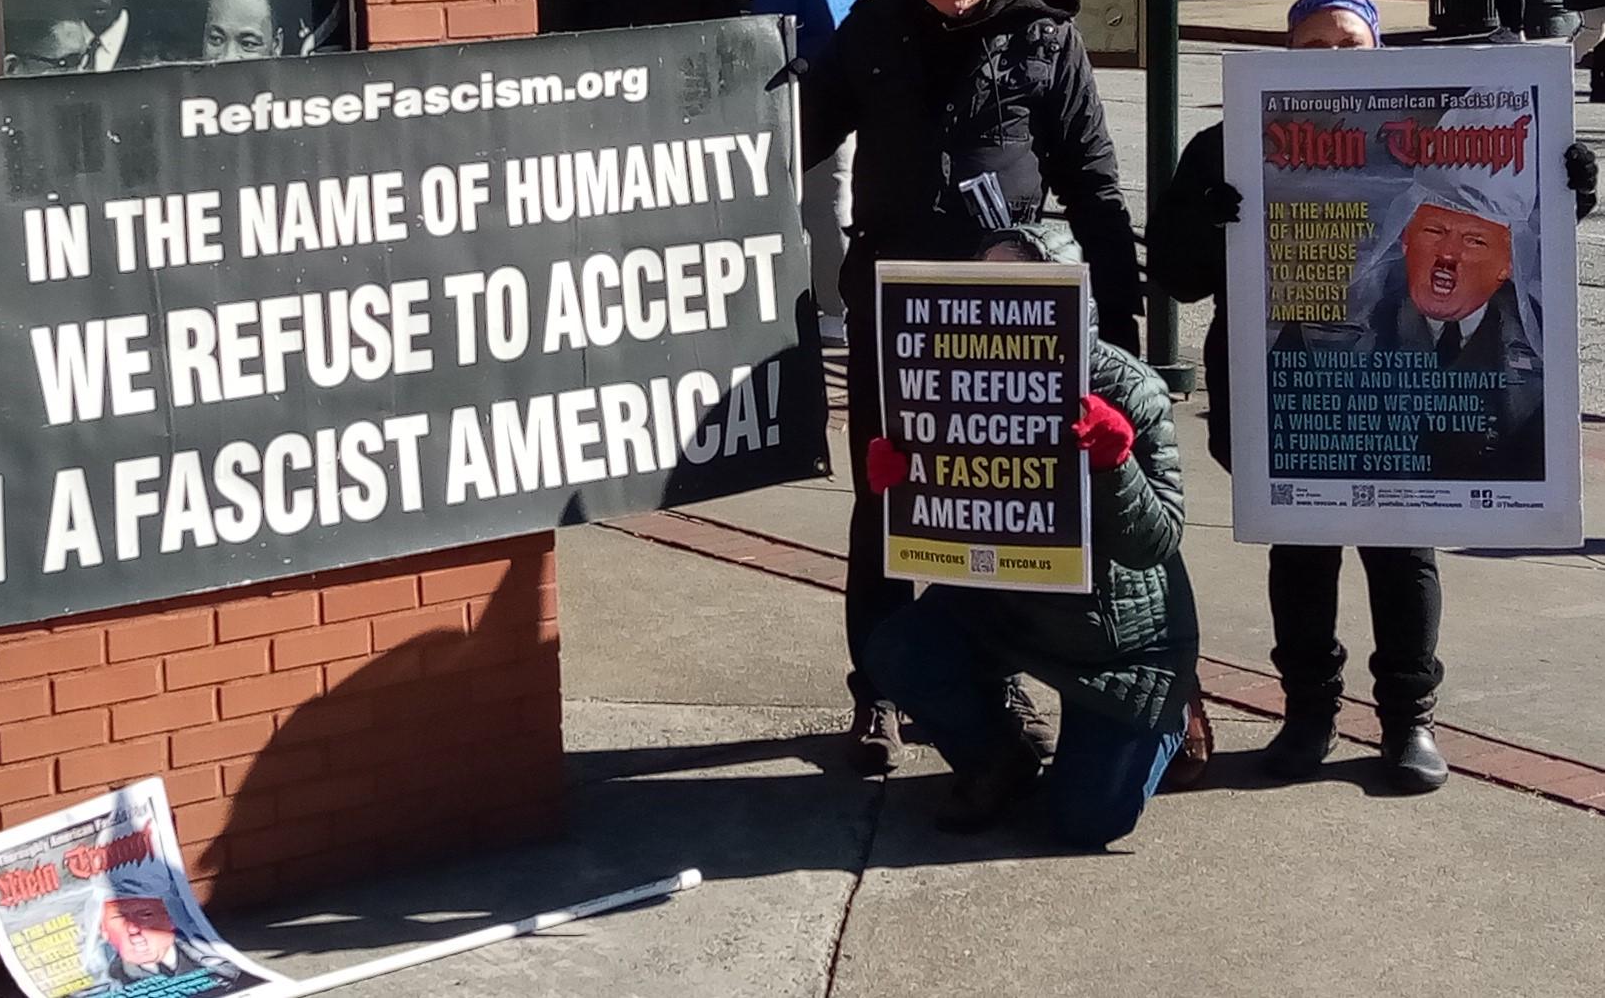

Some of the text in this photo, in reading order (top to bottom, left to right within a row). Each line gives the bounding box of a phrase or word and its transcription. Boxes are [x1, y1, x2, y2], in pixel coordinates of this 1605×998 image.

[181, 64, 649, 139] RefuseFascism.org
[1267, 92, 1529, 114] A Thoroughly American Fascist Pig!
[1265, 114, 1533, 176] Mein Trumpf
[25, 132, 773, 283] IN THE NAME OF HUMANITY
[1269, 202, 1368, 219] IN THE NAME
[1270, 223, 1288, 240] OF
[1270, 244, 1357, 260] WE REFUSE
[1271, 264, 1355, 281] TO ACCEPT
[1271, 285, 1348, 301] A FASCIST
[906, 298, 1056, 326] IN THE NAME
[1271, 305, 1347, 322] AMERICA!
[31, 235, 783, 425] WE REFUSE TO ACCEPT
[896, 332, 1065, 364] OF HUMANITY,
[1272, 352, 1438, 369] THIS WHOLE SYSTEM
[898, 369, 1063, 404] WE REFUSE
[1273, 371, 1507, 389] IS ROTTEN AND ILLEGITIMATE
[1273, 395, 1484, 412] WE NEED AND WE DEMAND:
[899, 411, 1063, 445] TO ACCEPT
[1274, 415, 1283, 430] A
[1289, 415, 1341, 431] WHOLE
[1348, 415, 1382, 431] NEW
[1388, 415, 1420, 431] WAY
[1426, 416, 1447, 432] TO
[1274, 435, 1418, 451] A FUNDAMENTALLY
[43, 361, 780, 572] A FASCIST AMERICA!
[910, 453, 1058, 489] A FASCIST
[1274, 454, 1432, 472] DIFFERENT SYSTEM!
[912, 495, 1055, 532] AMERICA!
[999, 558, 1051, 570] REVCOM.US
